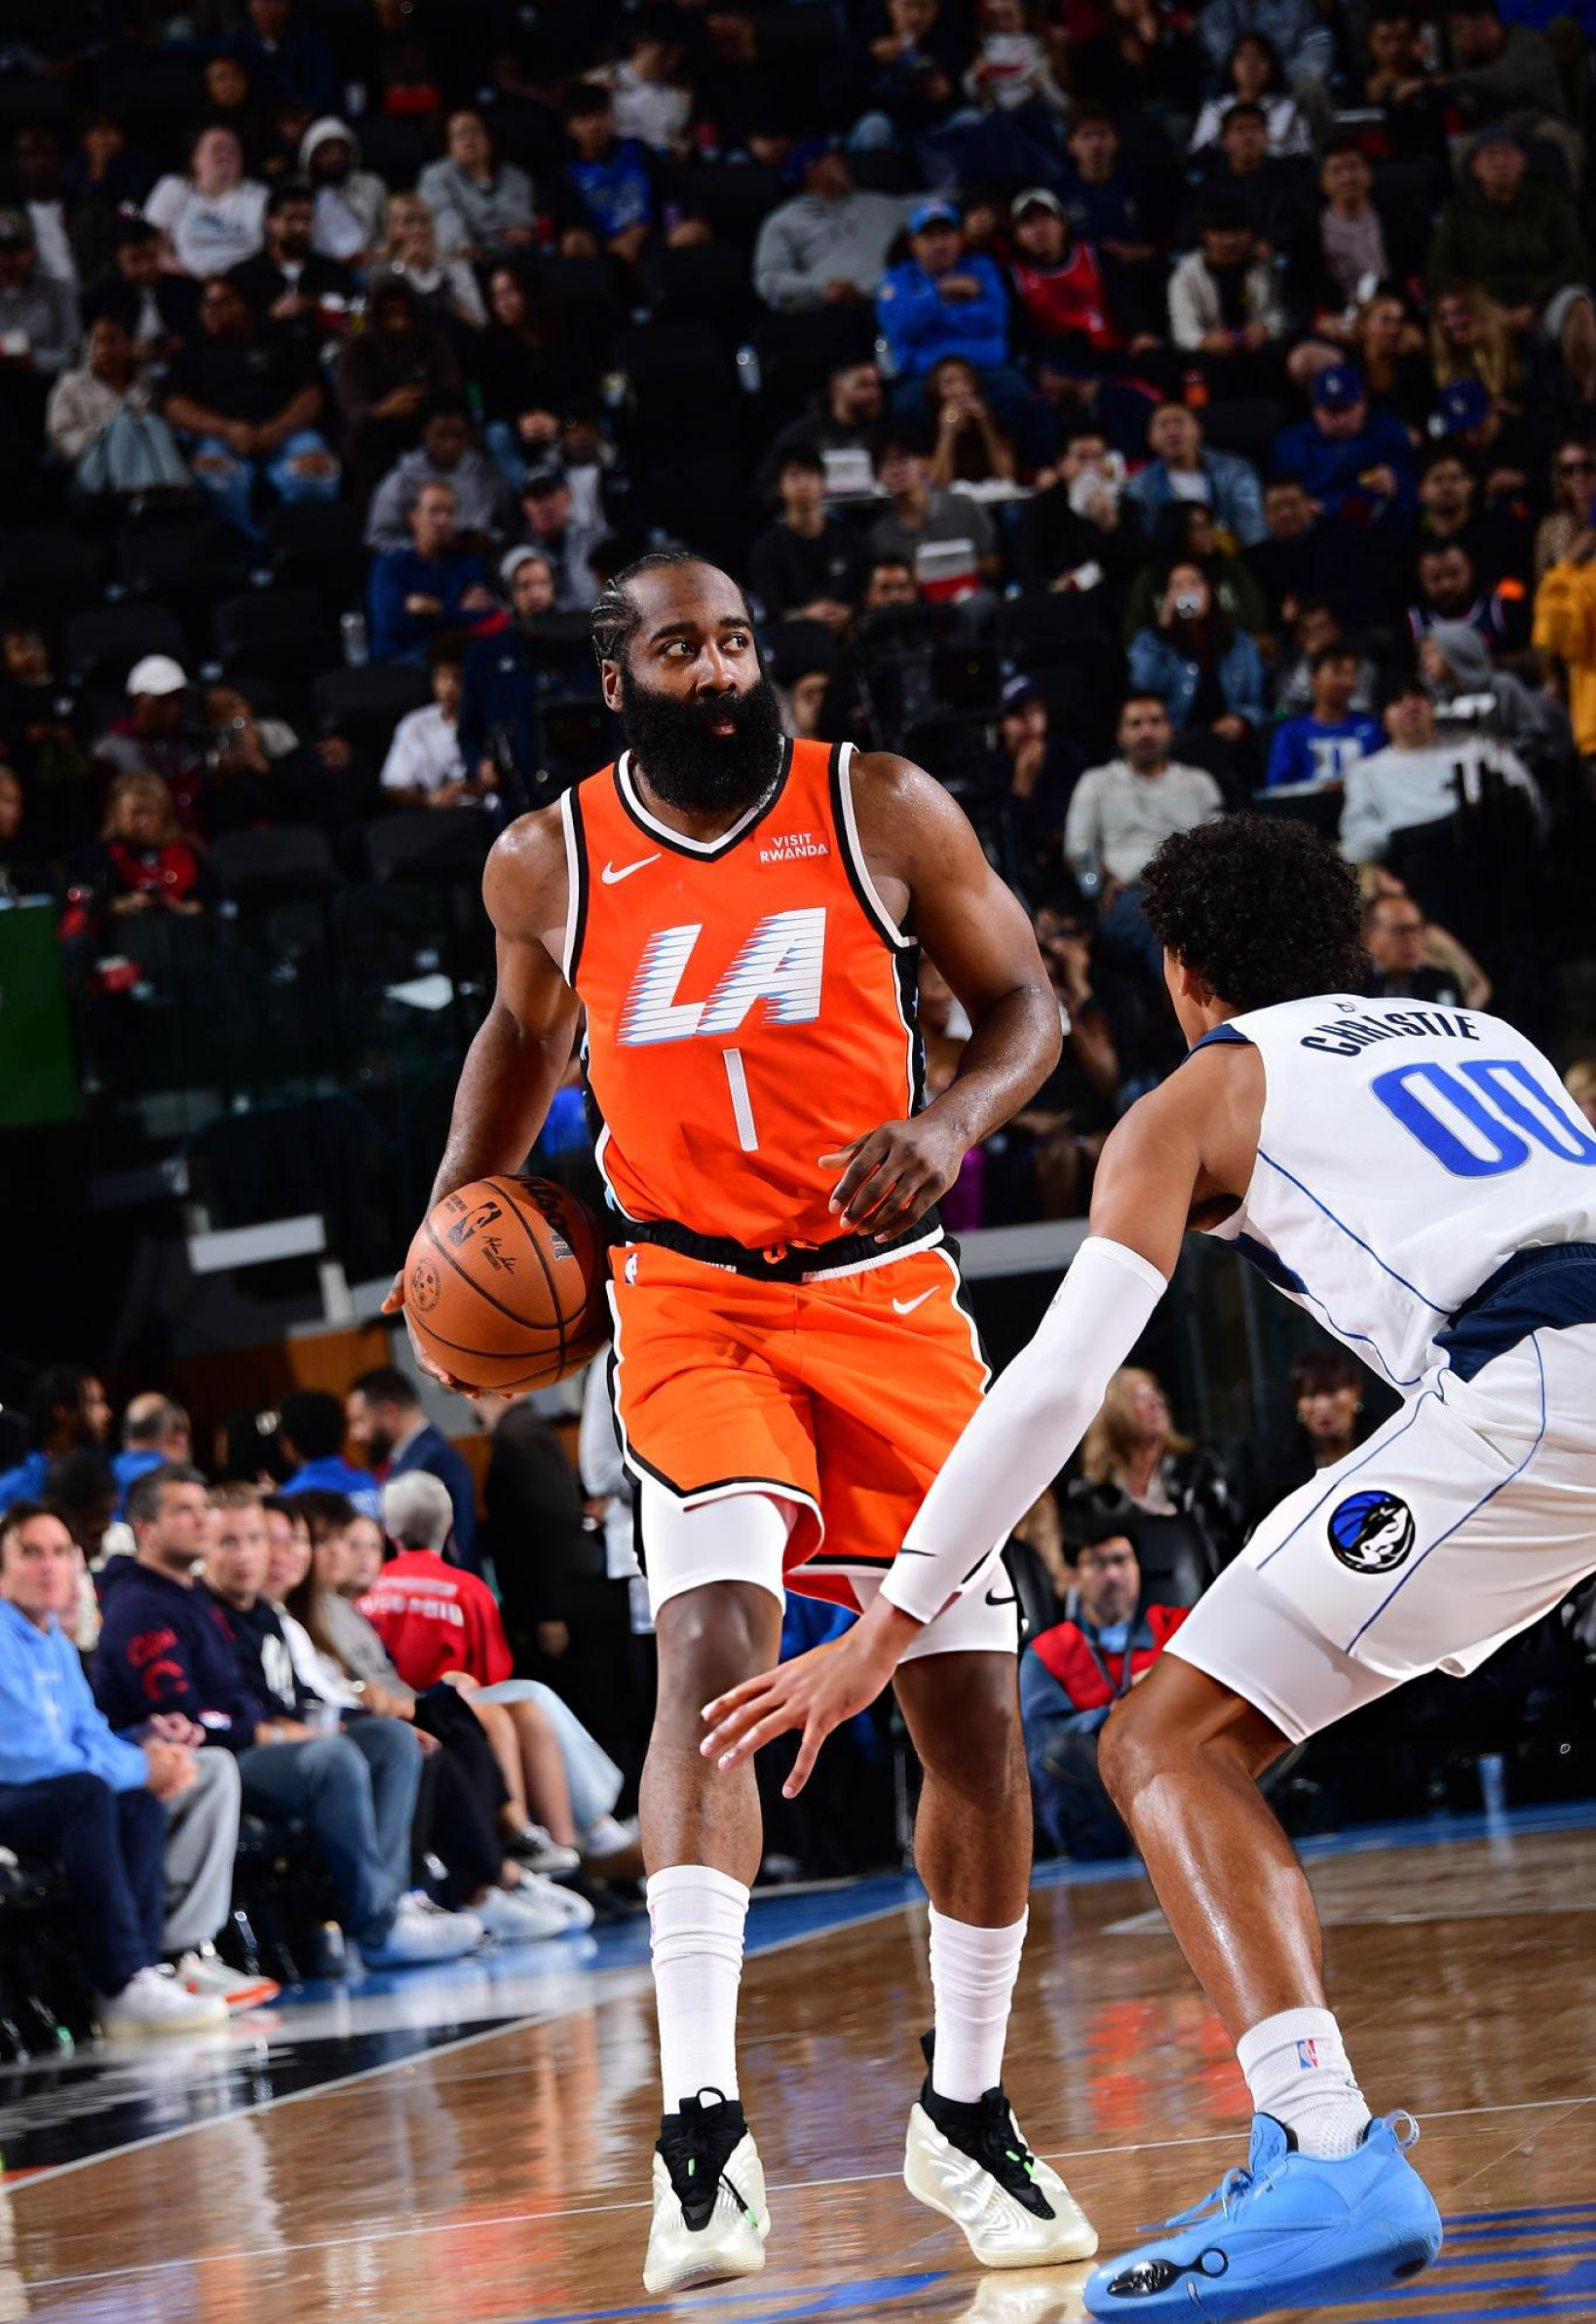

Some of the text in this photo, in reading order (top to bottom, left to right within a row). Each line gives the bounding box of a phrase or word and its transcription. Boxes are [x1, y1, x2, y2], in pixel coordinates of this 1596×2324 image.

[759, 843, 829, 862] RWANDA
[772, 833, 812, 848] VISIT
[617, 906, 827, 1047] LA
[1299, 1011, 1481, 1057] CHRISTIE
[722, 1048, 760, 1152] 1
[1368, 1059, 1596, 1179] 00
